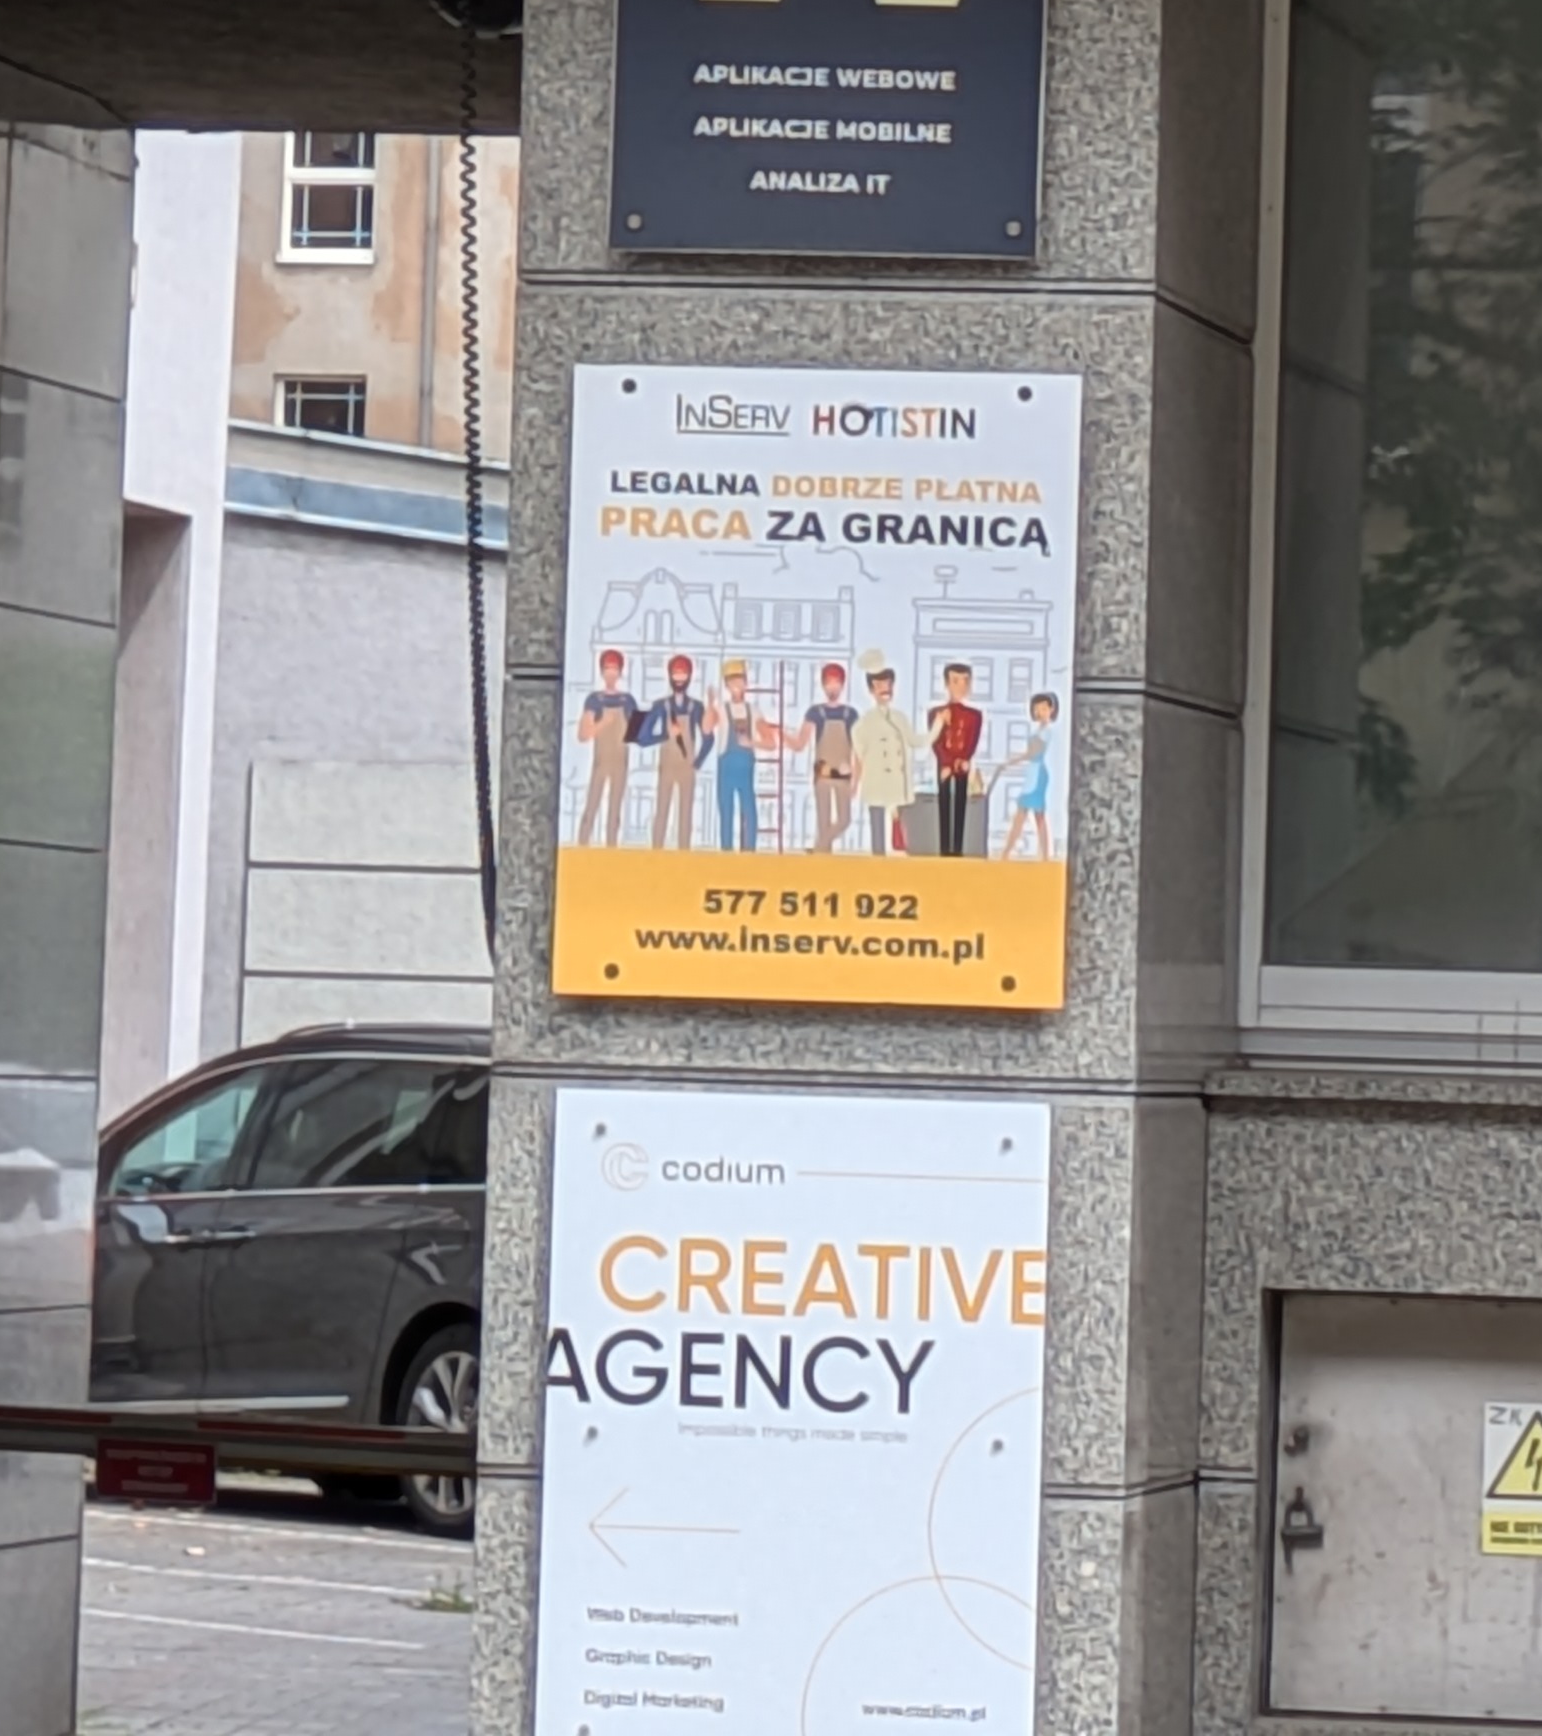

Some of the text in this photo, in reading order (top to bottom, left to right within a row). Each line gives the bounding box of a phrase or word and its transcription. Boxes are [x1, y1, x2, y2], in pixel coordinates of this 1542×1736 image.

[694, 65, 955, 90] APLIKACJE WEBOWE
[694, 117, 951, 143] APLIKACJE MOBILNE
[750, 171, 890, 194] ANALIZA IT
[813, 404, 975, 438] HOTISTIN
[611, 471, 1041, 503] LEGALNA DOBRZE PŁATNA
[601, 506, 1050, 557] PRACA ZA GRANICĄ
[705, 889, 917, 920] 577 511 922
[636, 922, 984, 965] www.inserv.com.pl
[662, 1155, 785, 1184] codium
[600, 1235, 1048, 1326] CREATIVE
[546, 1328, 934, 1414] AGENCY
[629, 1608, 738, 1626] Development
[585, 1648, 712, 1670] Graphic Design
[584, 1690, 724, 1713] Digital Marketing
